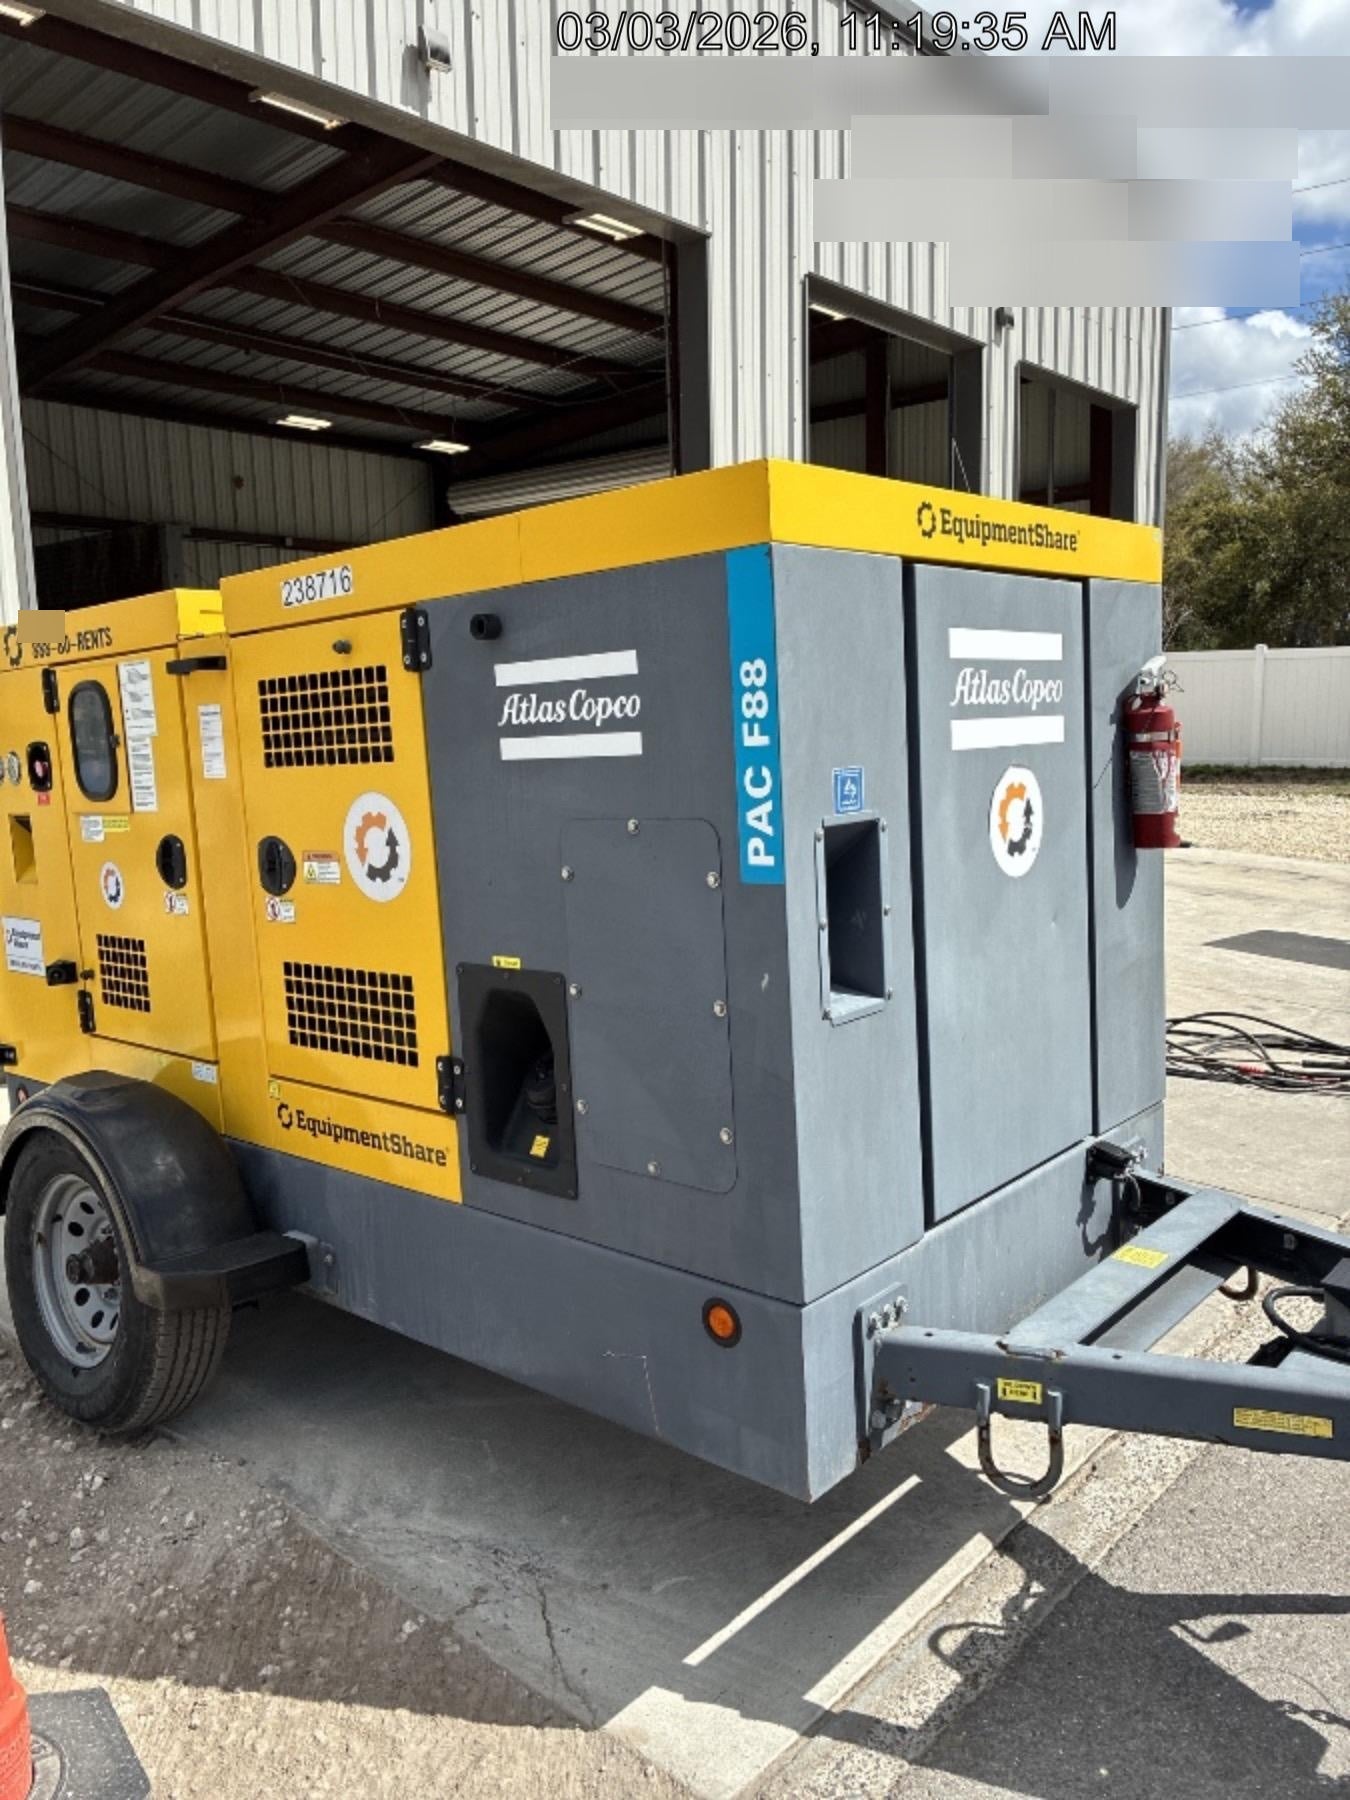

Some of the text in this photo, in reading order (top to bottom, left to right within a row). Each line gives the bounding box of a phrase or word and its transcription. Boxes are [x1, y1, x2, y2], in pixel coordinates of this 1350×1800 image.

[939, 507, 1078, 552] EquipmentShare
[283, 564, 352, 606] 238716
[497, 688, 641, 728] Atlas Copco
[949, 667, 1063, 711] Atlas Copco
[739, 658, 775, 867] PAC F88
[295, 1108, 448, 1167] EquipmentShare
